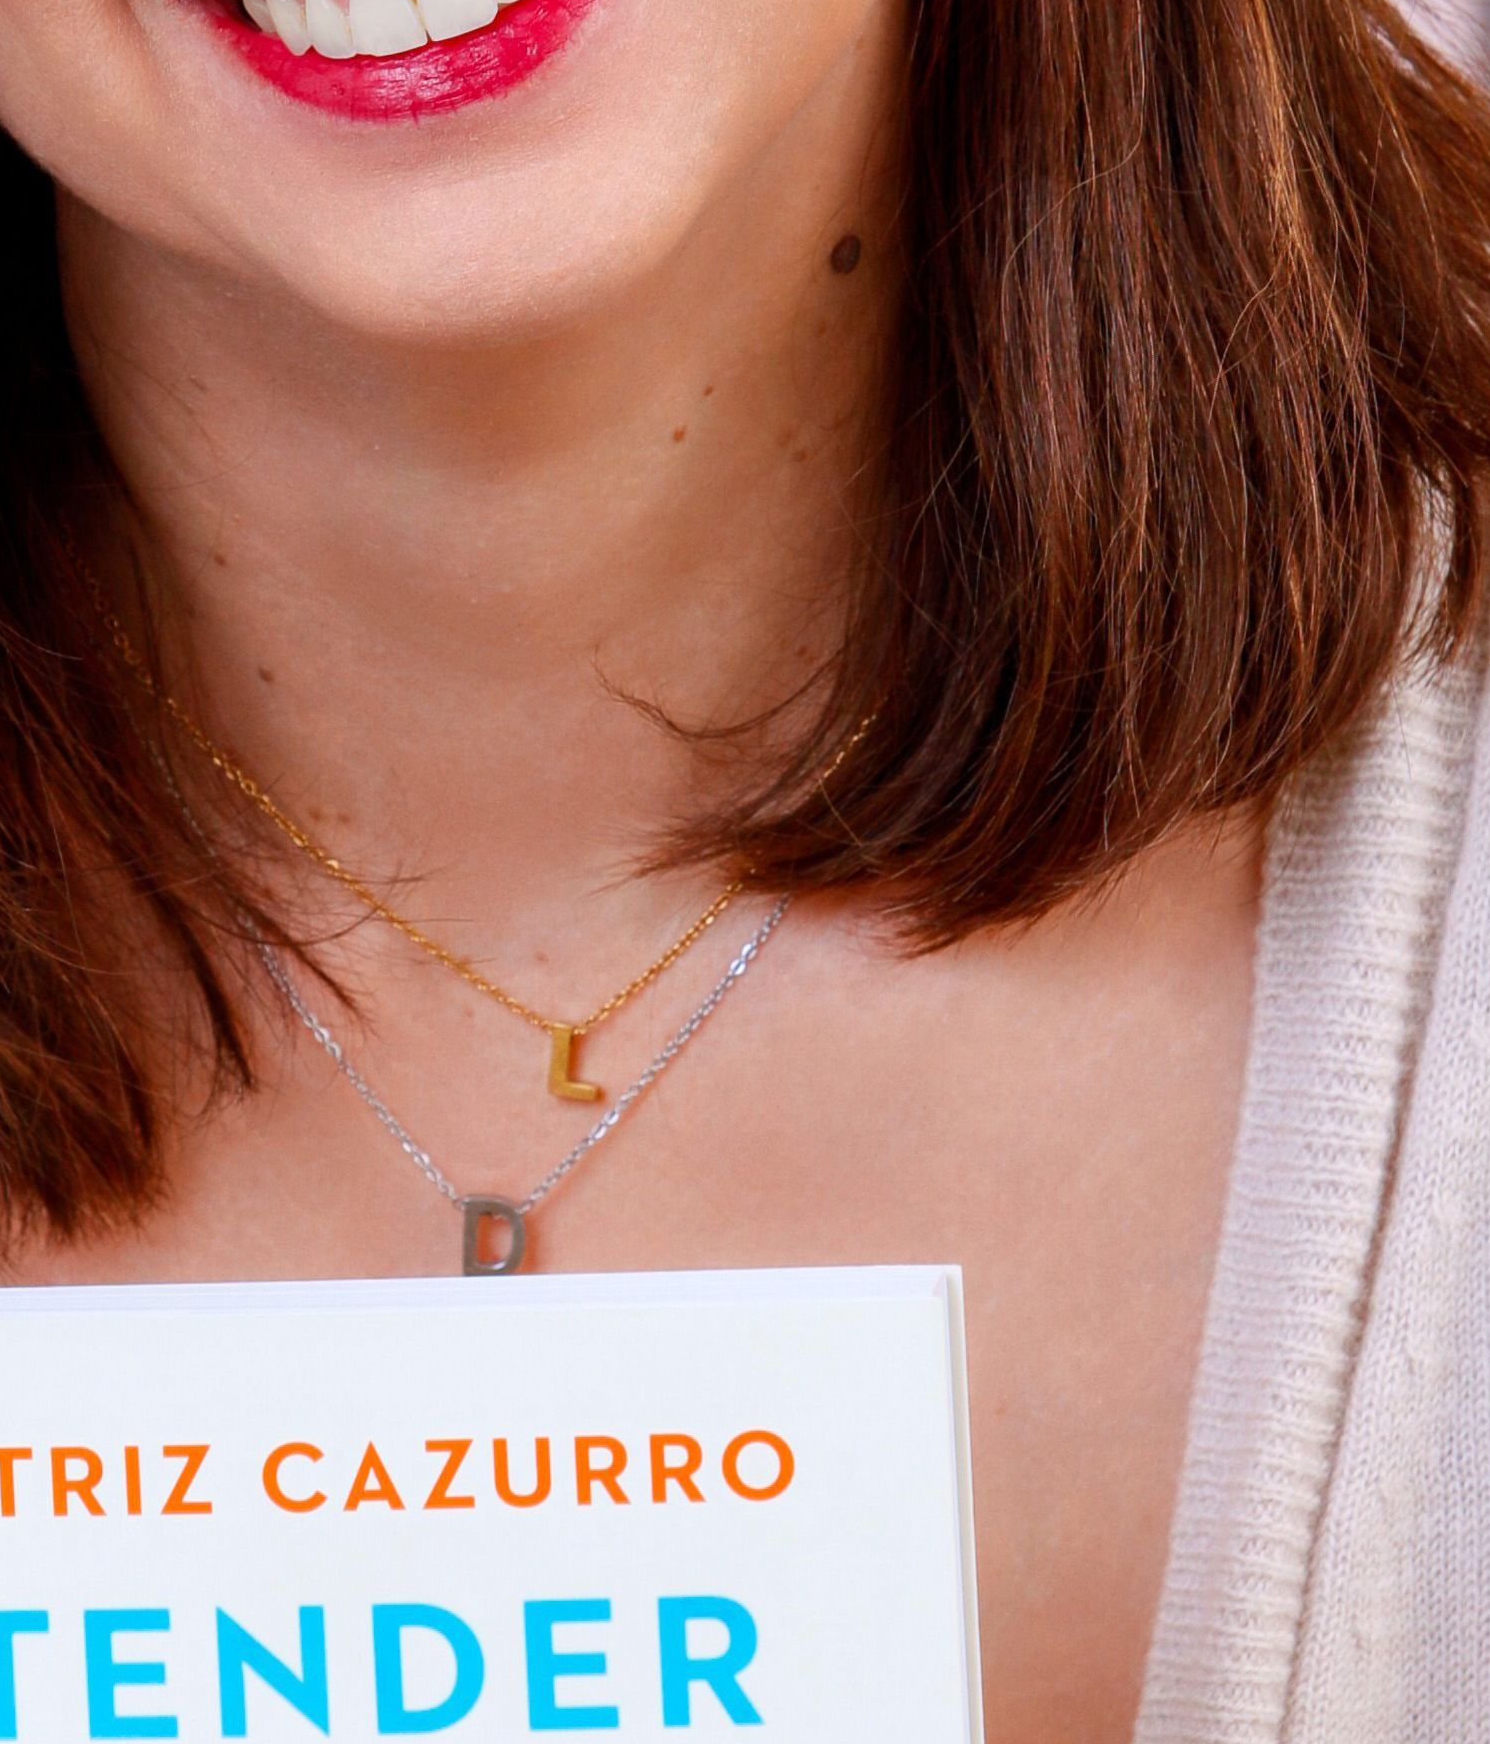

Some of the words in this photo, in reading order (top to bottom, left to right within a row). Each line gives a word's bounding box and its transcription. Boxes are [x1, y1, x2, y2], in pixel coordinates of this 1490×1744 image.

[548, 1021, 603, 1100] L
[462, 1194, 525, 1275] D
[262, 1430, 795, 1513] CAZURRO
